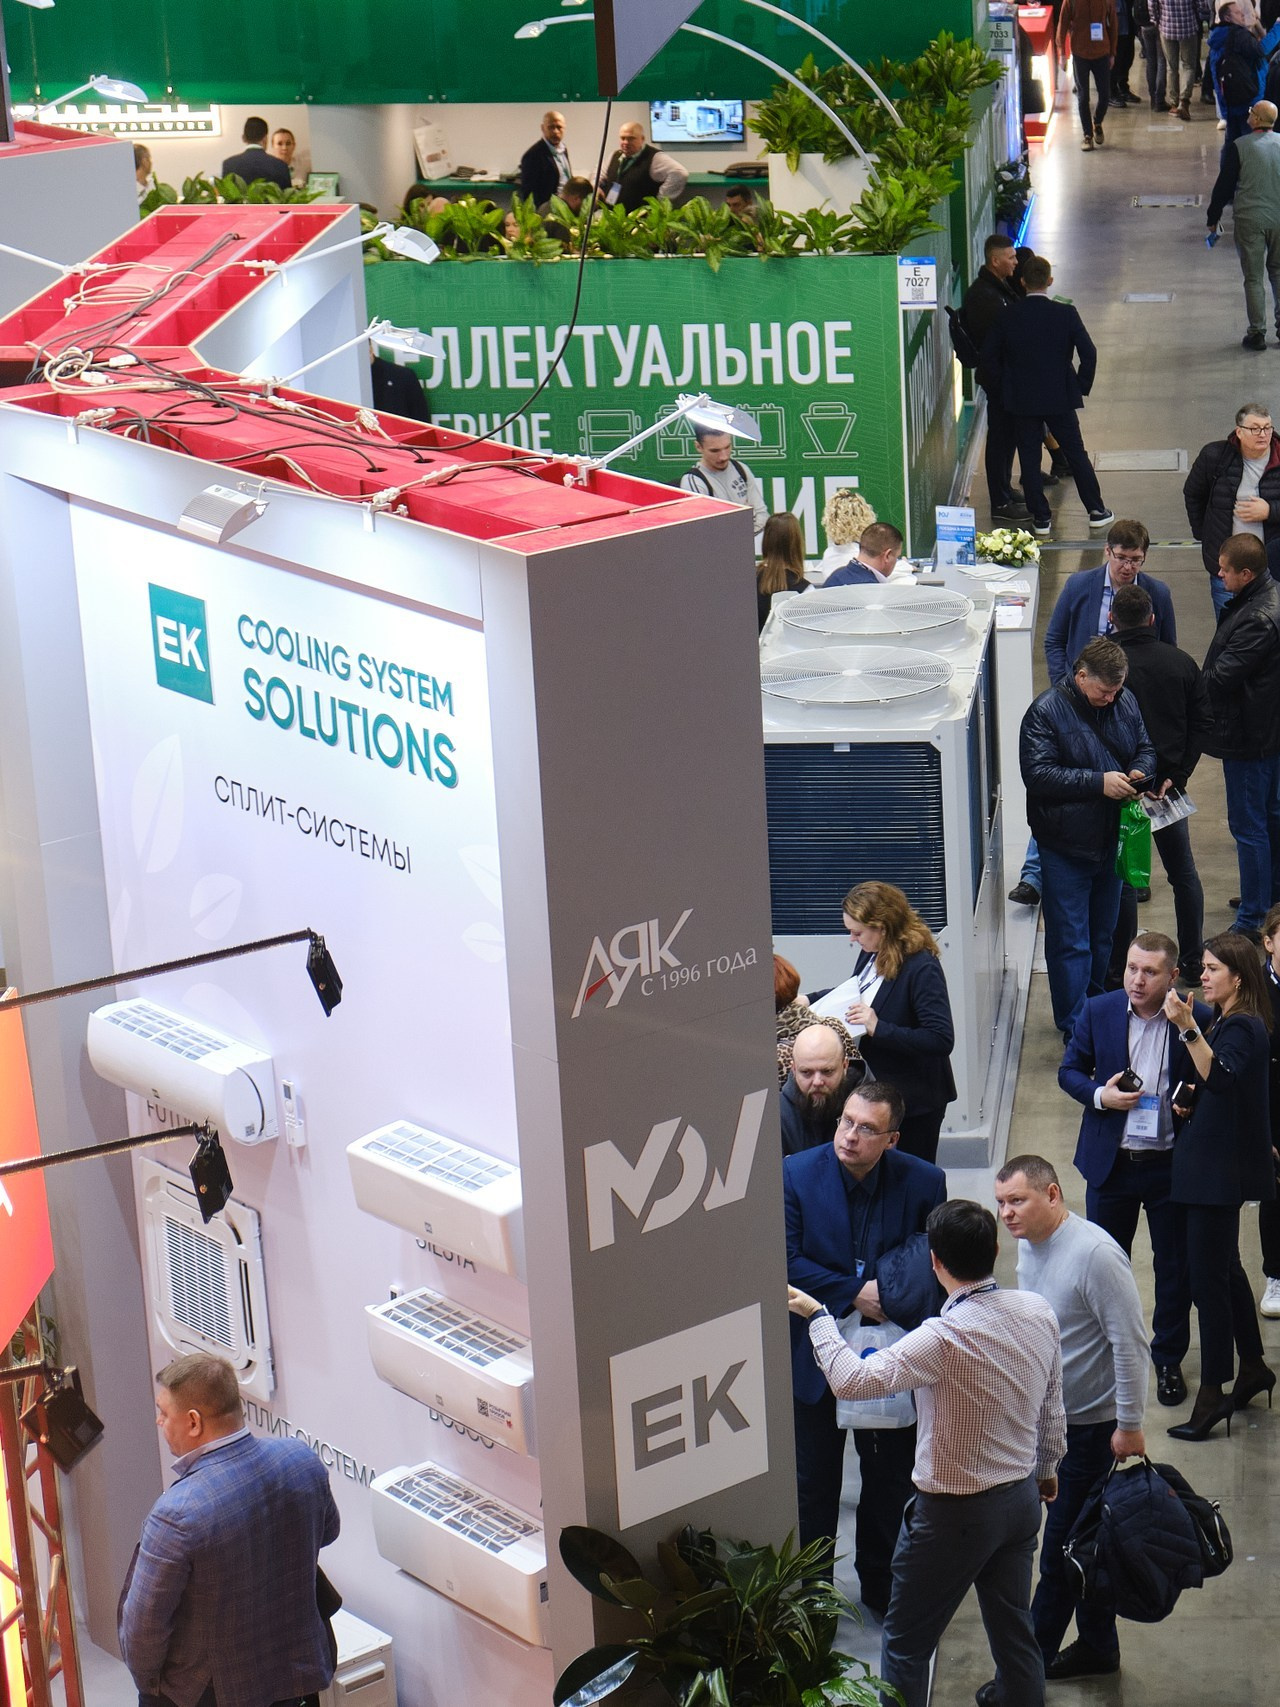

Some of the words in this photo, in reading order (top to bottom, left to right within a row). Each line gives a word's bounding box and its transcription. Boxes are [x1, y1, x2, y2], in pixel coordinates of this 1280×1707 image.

[989, 30, 1009, 38] 7033
[996, 22, 1002, 31] E
[904, 276, 930, 287] 7027
[913, 266, 921, 277] E
[155, 614, 206, 672] EK
[237, 613, 351, 681] COOLING
[357, 653, 455, 716] SYSTEM
[243, 667, 459, 789] SOLUTIONS
[214, 775, 412, 873] СПЛИТ-СИСТЕМЫ
[660, 963, 700, 991] 1996
[583, 1087, 769, 1252] MDV
[631, 1359, 751, 1472] EK
